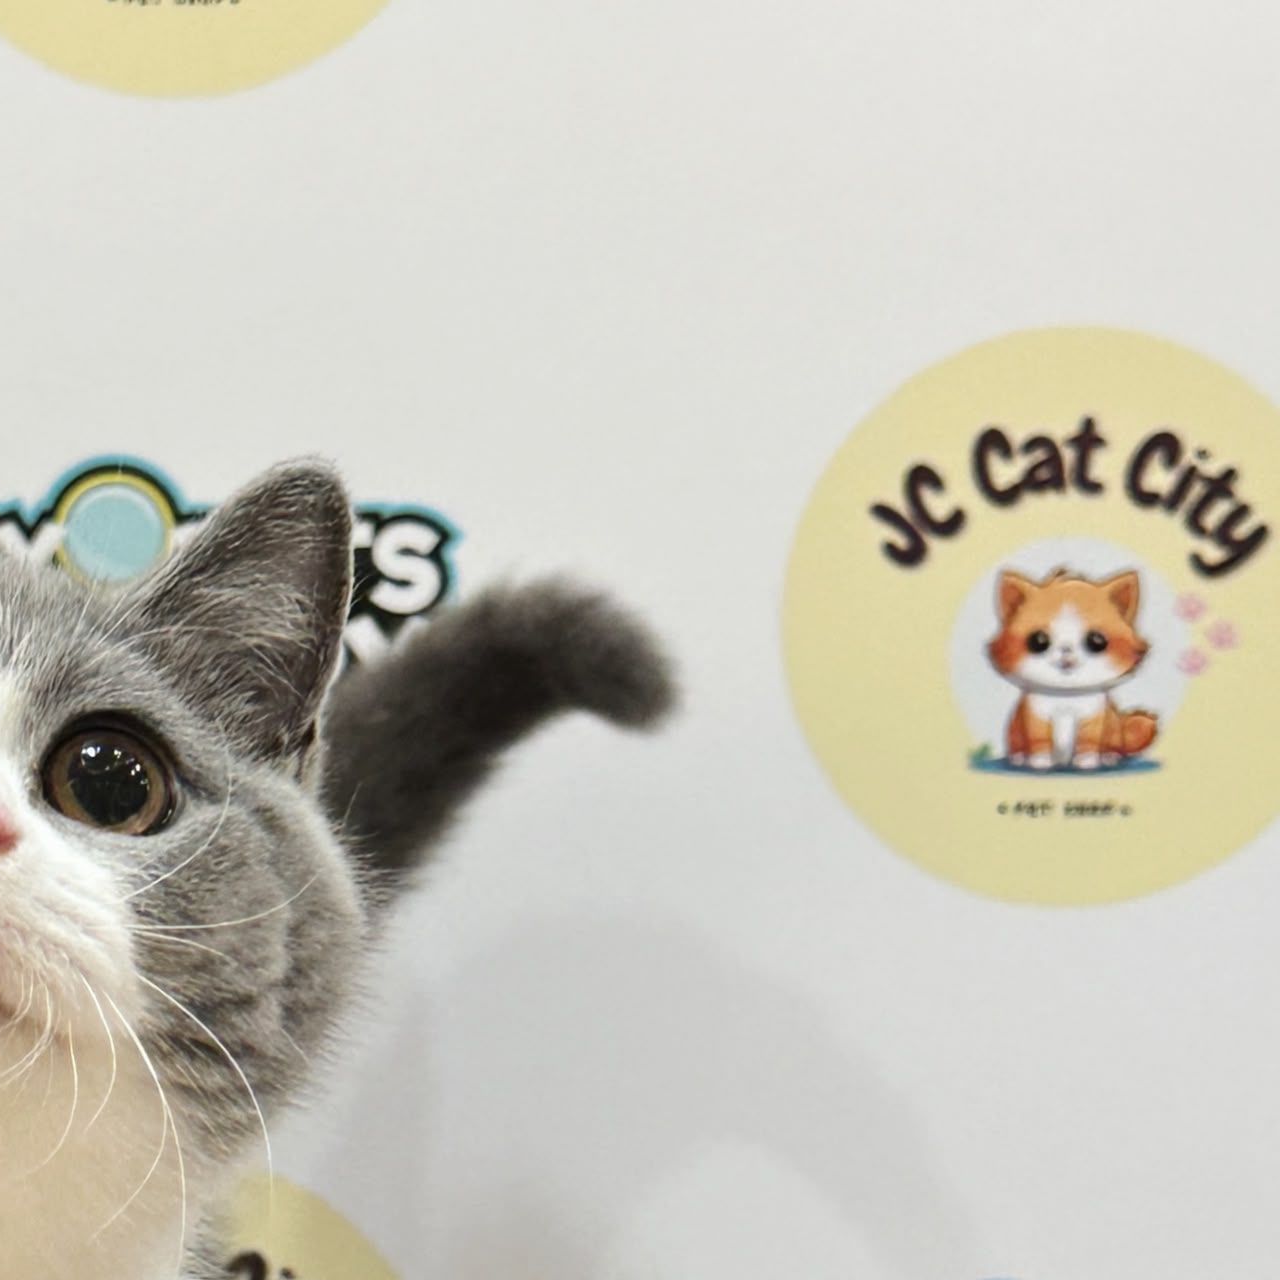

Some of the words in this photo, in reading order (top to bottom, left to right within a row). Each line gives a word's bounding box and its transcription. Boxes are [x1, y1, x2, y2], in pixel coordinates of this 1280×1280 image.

[869, 462, 968, 570] JC
[971, 416, 1108, 508] Cat
[1123, 430, 1271, 580] City
